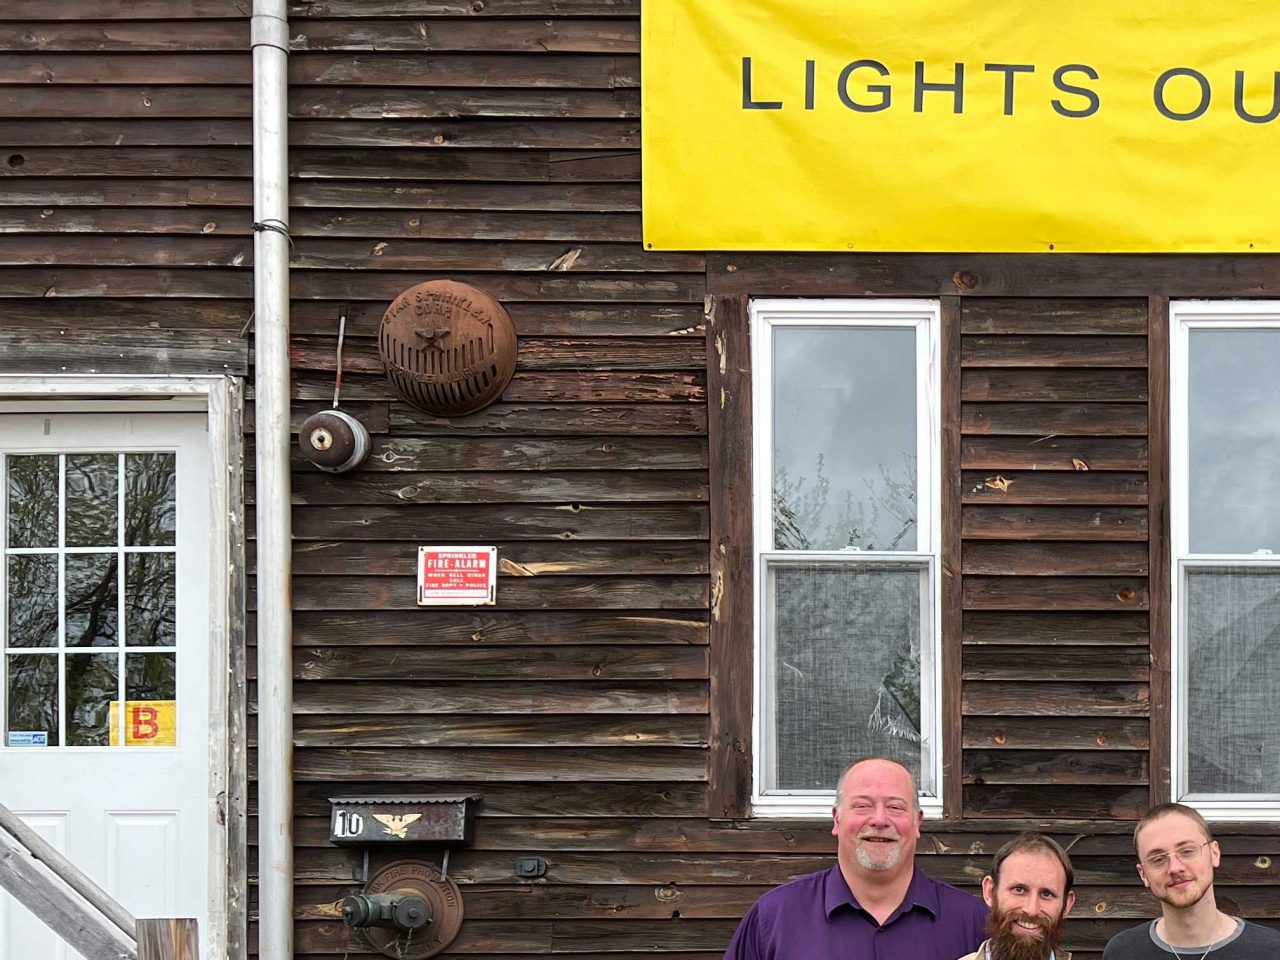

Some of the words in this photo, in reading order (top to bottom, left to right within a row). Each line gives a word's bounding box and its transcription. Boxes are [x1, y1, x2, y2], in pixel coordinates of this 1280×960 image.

[742, 56, 1101, 119] LIGHTS
[415, 289, 492, 325] SPRINKLER
[427, 559, 486, 569] FIRE-ALARM
[133, 706, 159, 740] B
[337, 811, 362, 836] 10
[384, 867, 406, 881] FIRE
[411, 866, 457, 908] PROCTION
